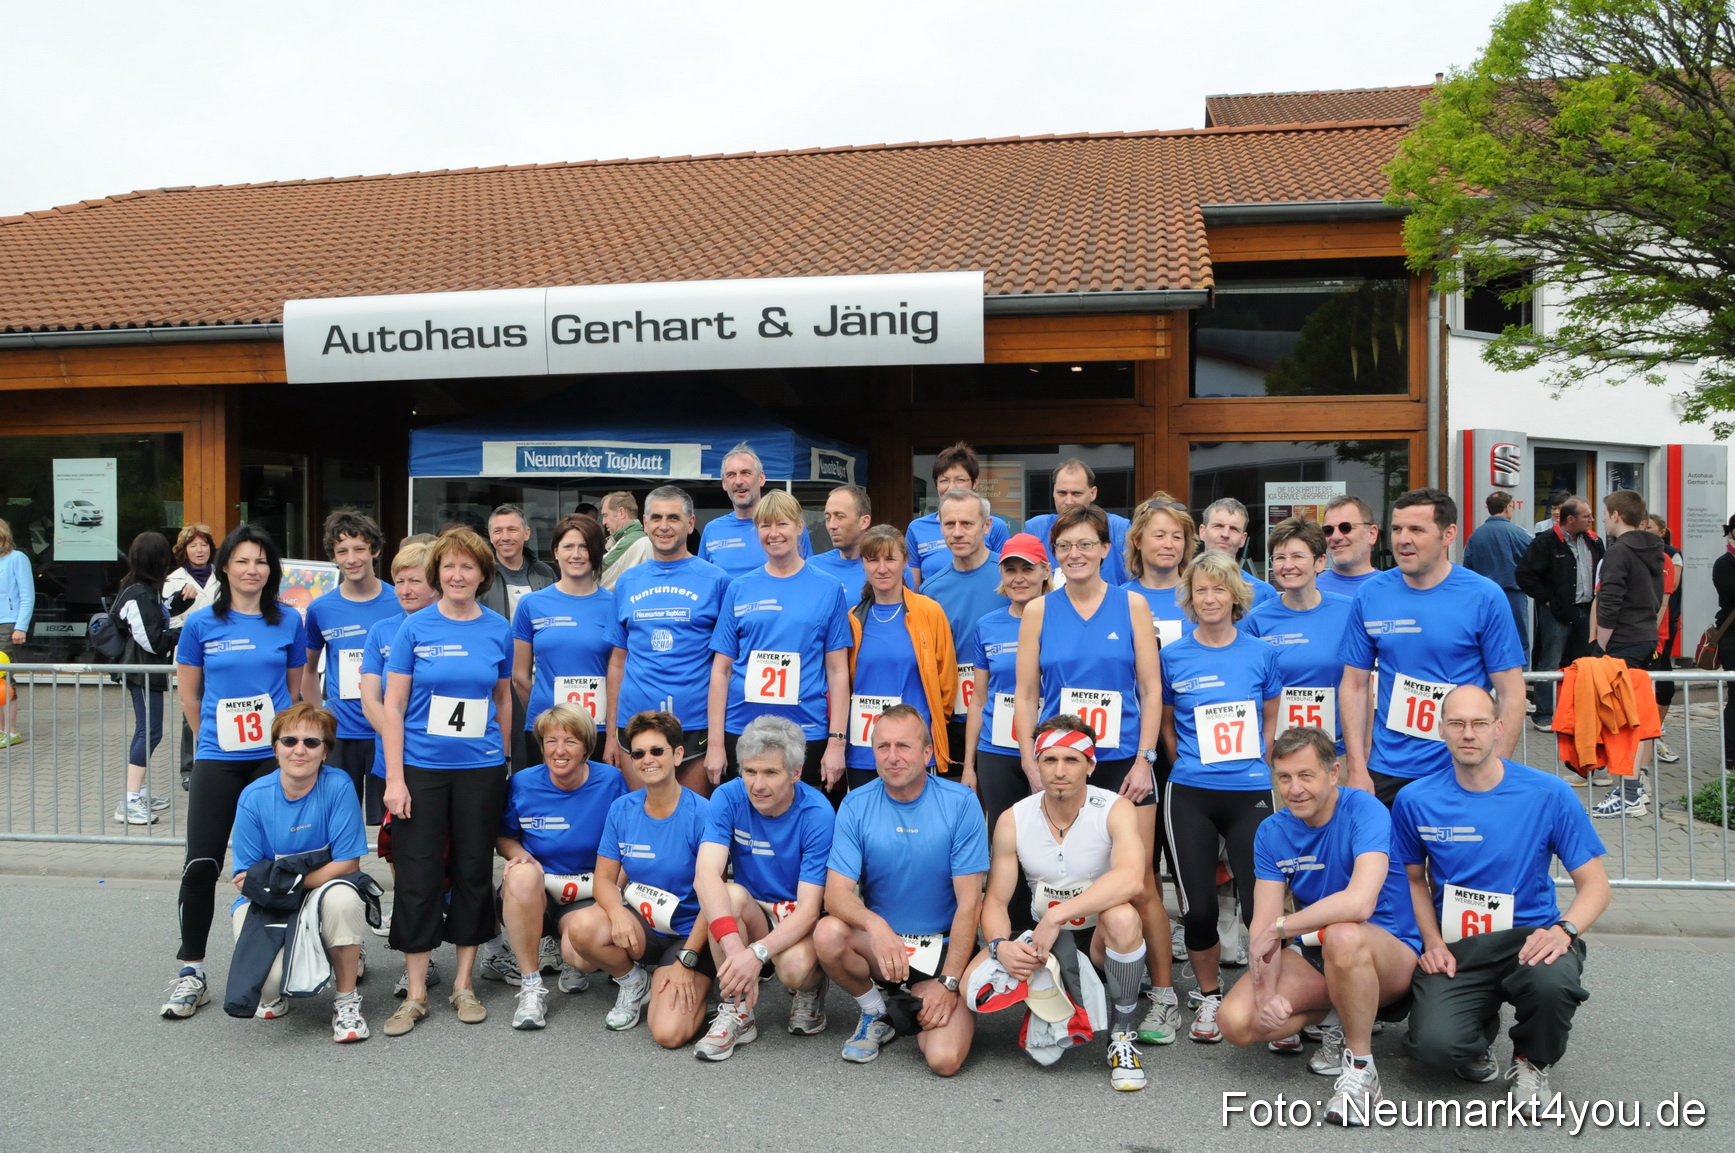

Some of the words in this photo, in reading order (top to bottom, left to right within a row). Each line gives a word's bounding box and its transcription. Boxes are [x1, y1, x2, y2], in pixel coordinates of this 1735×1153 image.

[322, 320, 528, 355] Autohaus
[551, 310, 737, 345] Gerhart
[757, 306, 793, 338] &
[813, 301, 938, 344] Jänig
[524, 450, 603, 468] Neumarkter
[605, 451, 663, 471] Tagblatt
[1295, 485, 1321, 493] SCHRITTE
[1278, 492, 1300, 500] SERVICE
[630, 586, 699, 604] funrunners
[757, 652, 780, 661] MEYER
[760, 667, 787, 697] 21
[1403, 679, 1431, 692] MEYER
[1071, 691, 1099, 699] MEYER
[1285, 689, 1313, 697] MEYER
[1403, 686, 1431, 698] WERBUNG
[225, 701, 252, 709] MEYER
[1205, 705, 1234, 716] MEYER
[448, 701, 466, 732] 4
[1205, 711, 1235, 720] WERBUNG
[1406, 696, 1436, 732] 16
[233, 712, 263, 743] 13
[1077, 707, 1108, 741] 10
[1213, 720, 1245, 756] 67
[560, 882, 578, 904] 9
[635, 884, 659, 898] MEYER
[1044, 886, 1071, 896] MEYER
[1454, 889, 1486, 902] MEYER
[1454, 897, 1486, 907] WERBUNG
[1461, 909, 1492, 938] 61
